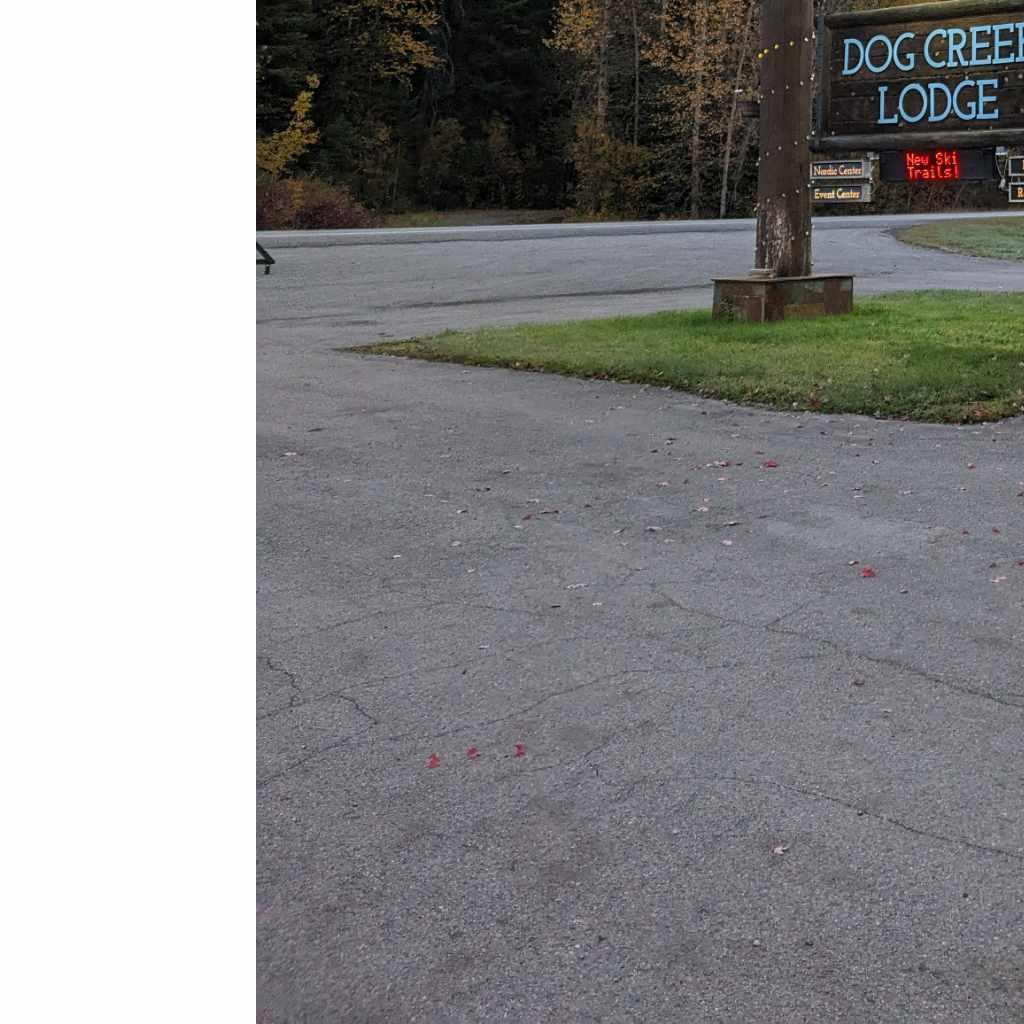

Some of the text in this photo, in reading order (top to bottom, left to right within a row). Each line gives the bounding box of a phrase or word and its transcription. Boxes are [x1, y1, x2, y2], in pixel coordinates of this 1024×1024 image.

[842, 32, 915, 75] DOG
[877, 79, 998, 124] LODGE
[906, 151, 958, 166] New Ski
[813, 164, 862, 176] Nordic Center
[814, 188, 861, 200] Event Center
